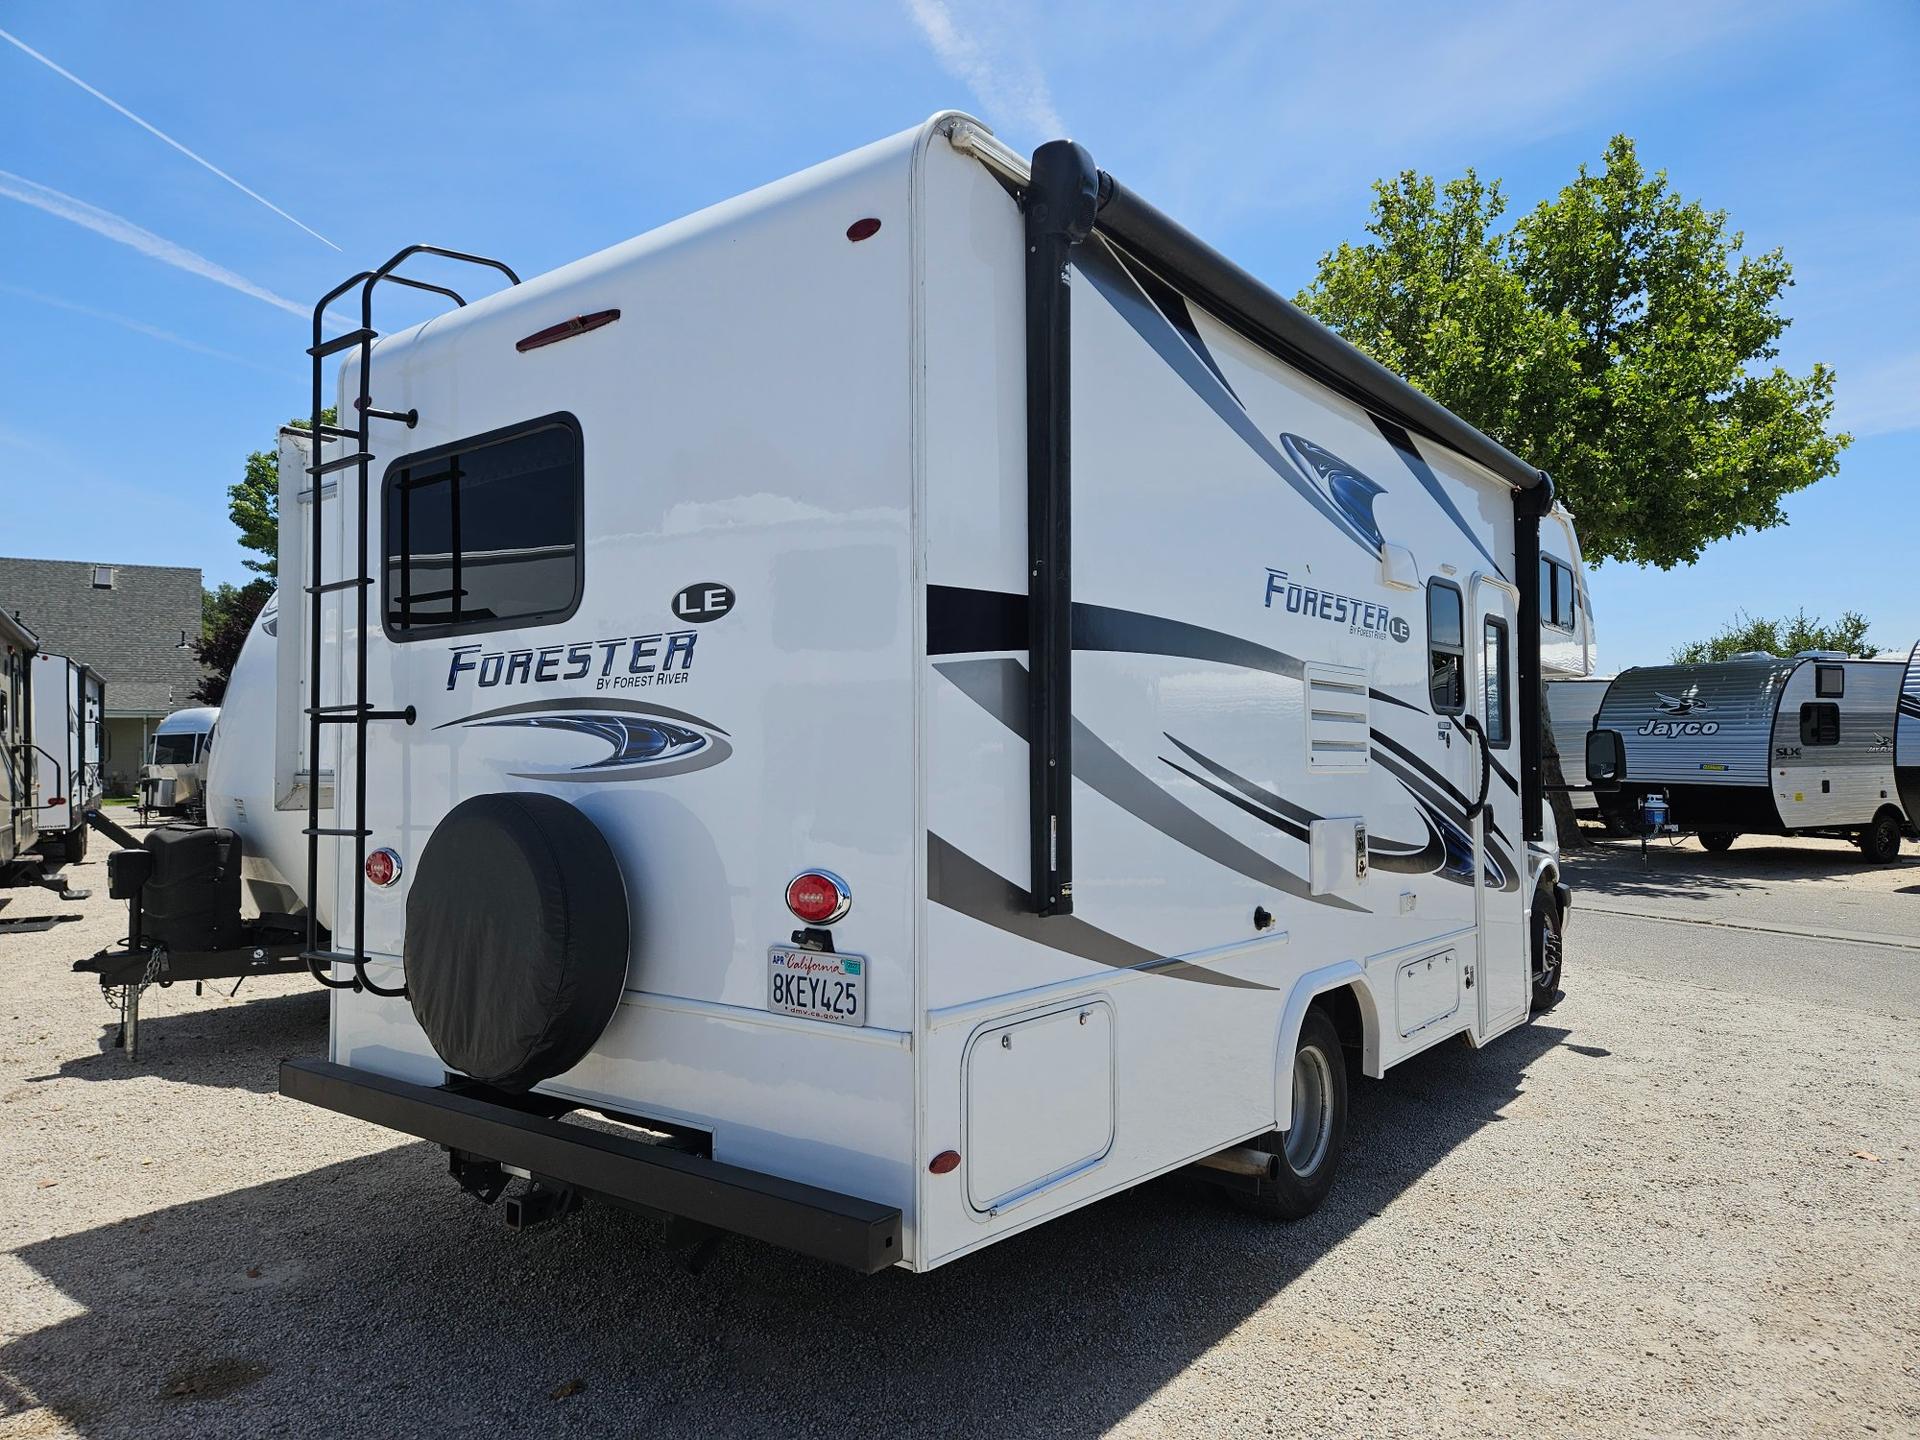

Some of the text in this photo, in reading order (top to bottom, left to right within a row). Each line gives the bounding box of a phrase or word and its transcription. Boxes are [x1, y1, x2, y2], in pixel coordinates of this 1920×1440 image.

[679, 588, 727, 614] LE
[1265, 567, 1389, 631] FORESTER
[1350, 625, 1358, 635] BY
[1357, 627, 1374, 639] FOREST
[1391, 621, 1408, 638] LE
[446, 630, 698, 691] FORESTER
[596, 672, 689, 690] BY FOREST RIVER
[1638, 719, 1720, 739] Jayco
[772, 954, 785, 965] APR
[786, 953, 845, 975] California
[773, 972, 857, 1016] 8KEY425
[790, 1007, 840, 1021] dmv.ca.gov
